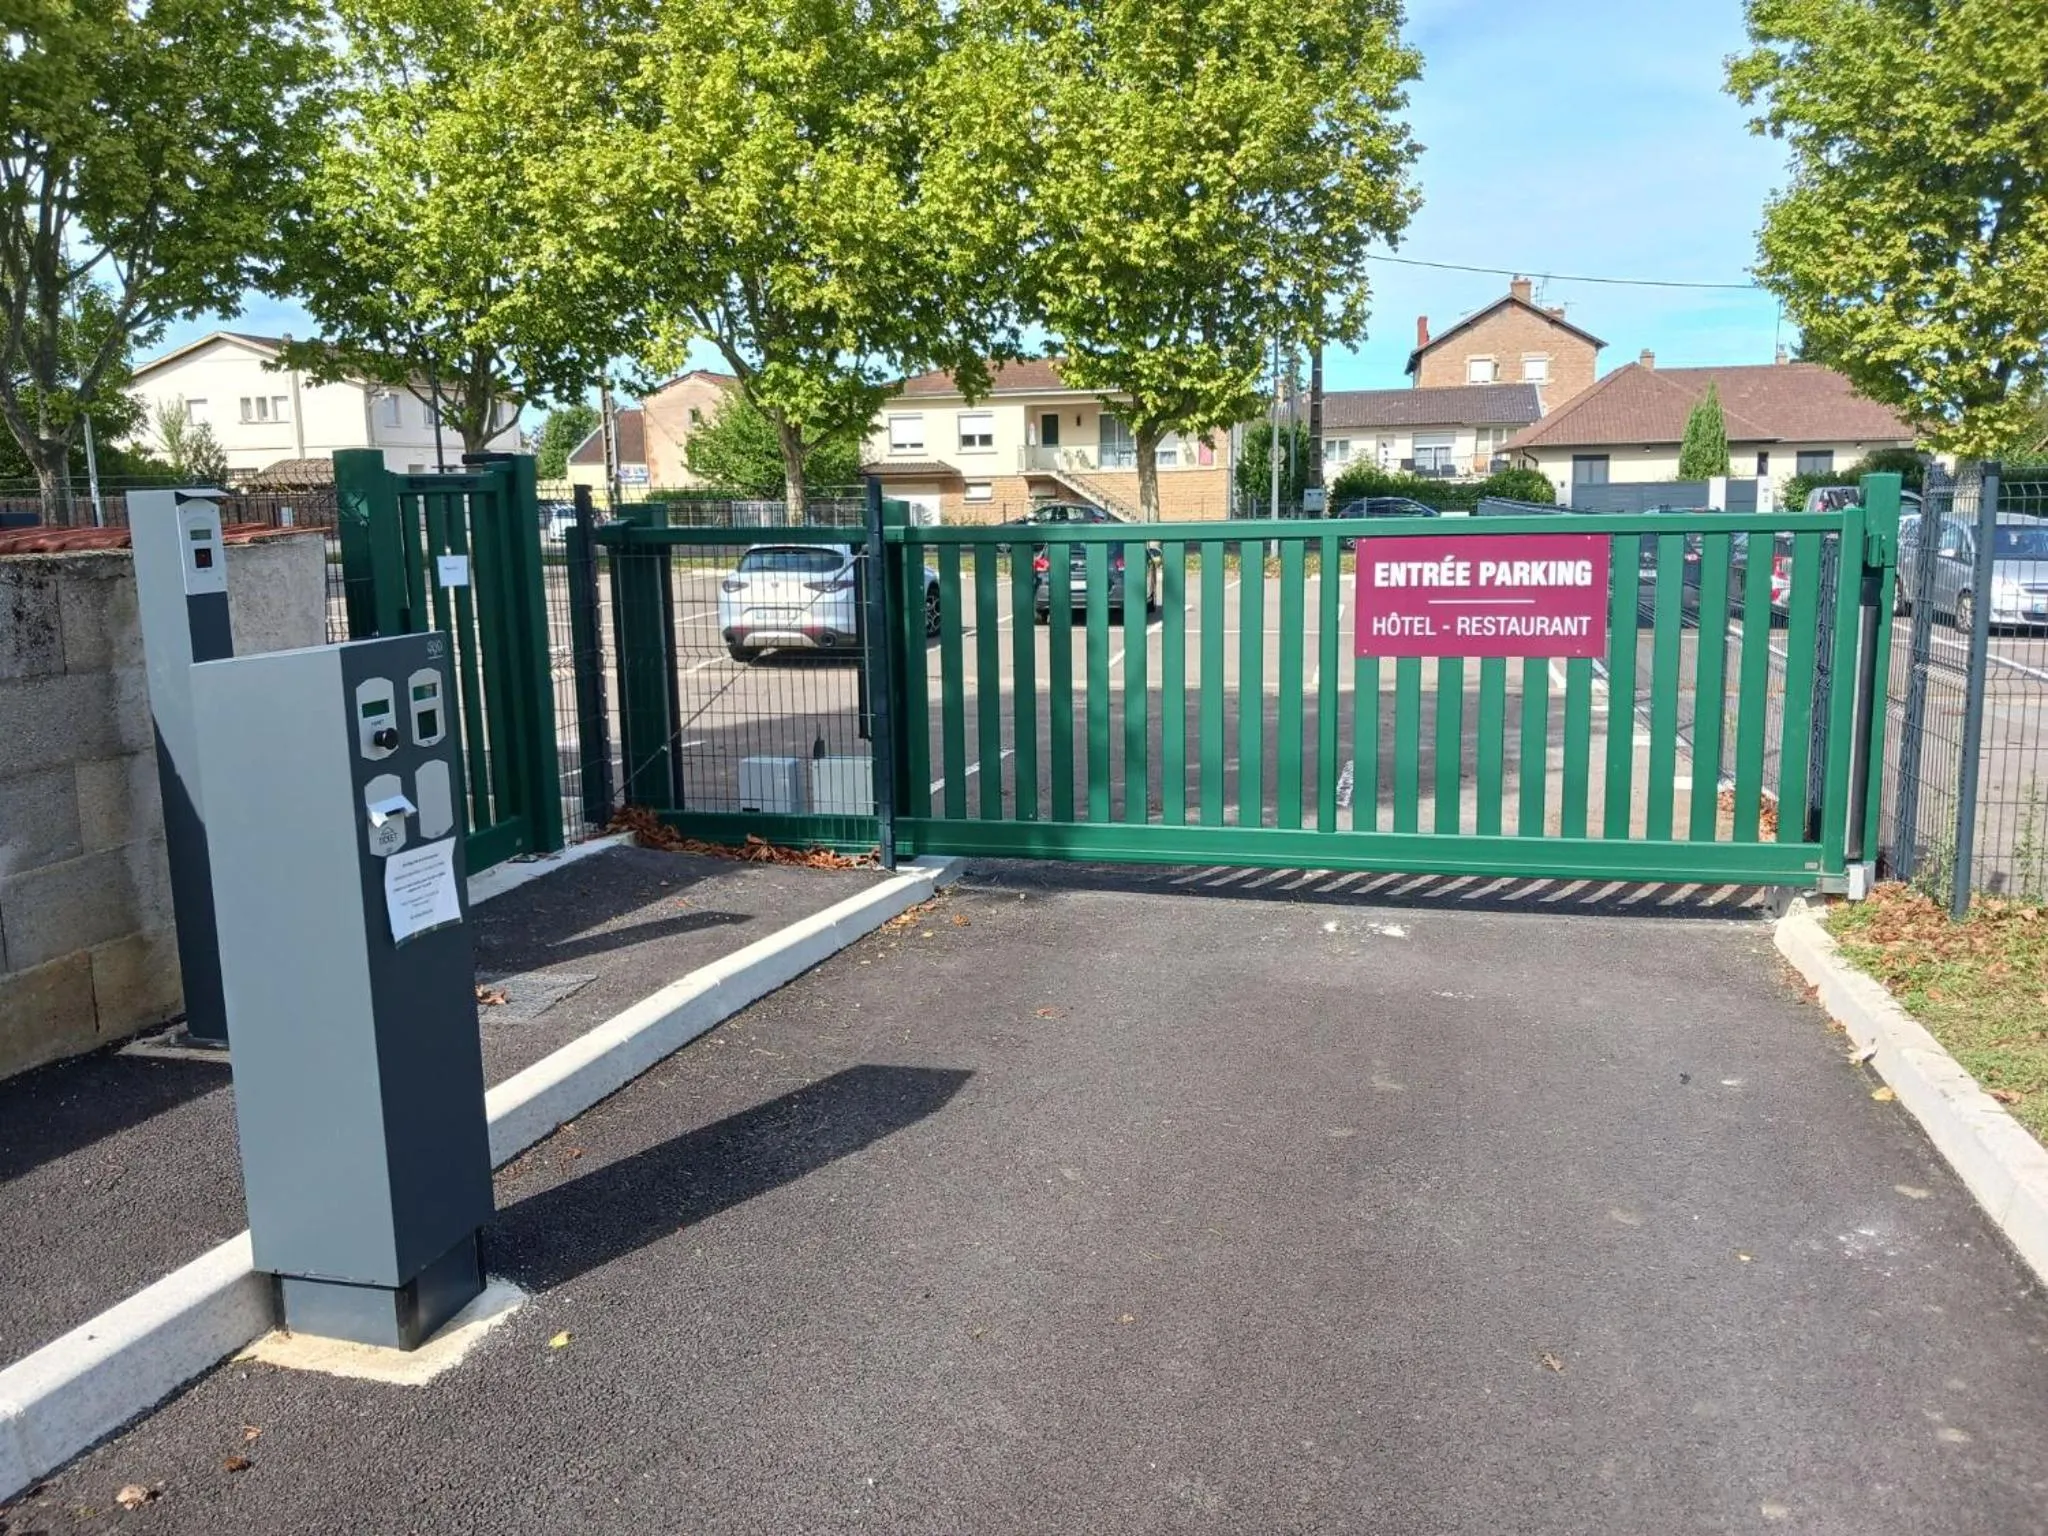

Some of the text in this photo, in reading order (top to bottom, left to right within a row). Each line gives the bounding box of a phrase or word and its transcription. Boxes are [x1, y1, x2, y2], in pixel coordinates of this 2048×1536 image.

[1374, 555, 1593, 587] ENTRÉE PARKING
[1372, 612, 1437, 636] HÔTEL
[1456, 616, 1592, 637] RESTAURANT
[378, 832, 398, 845] TICKET
